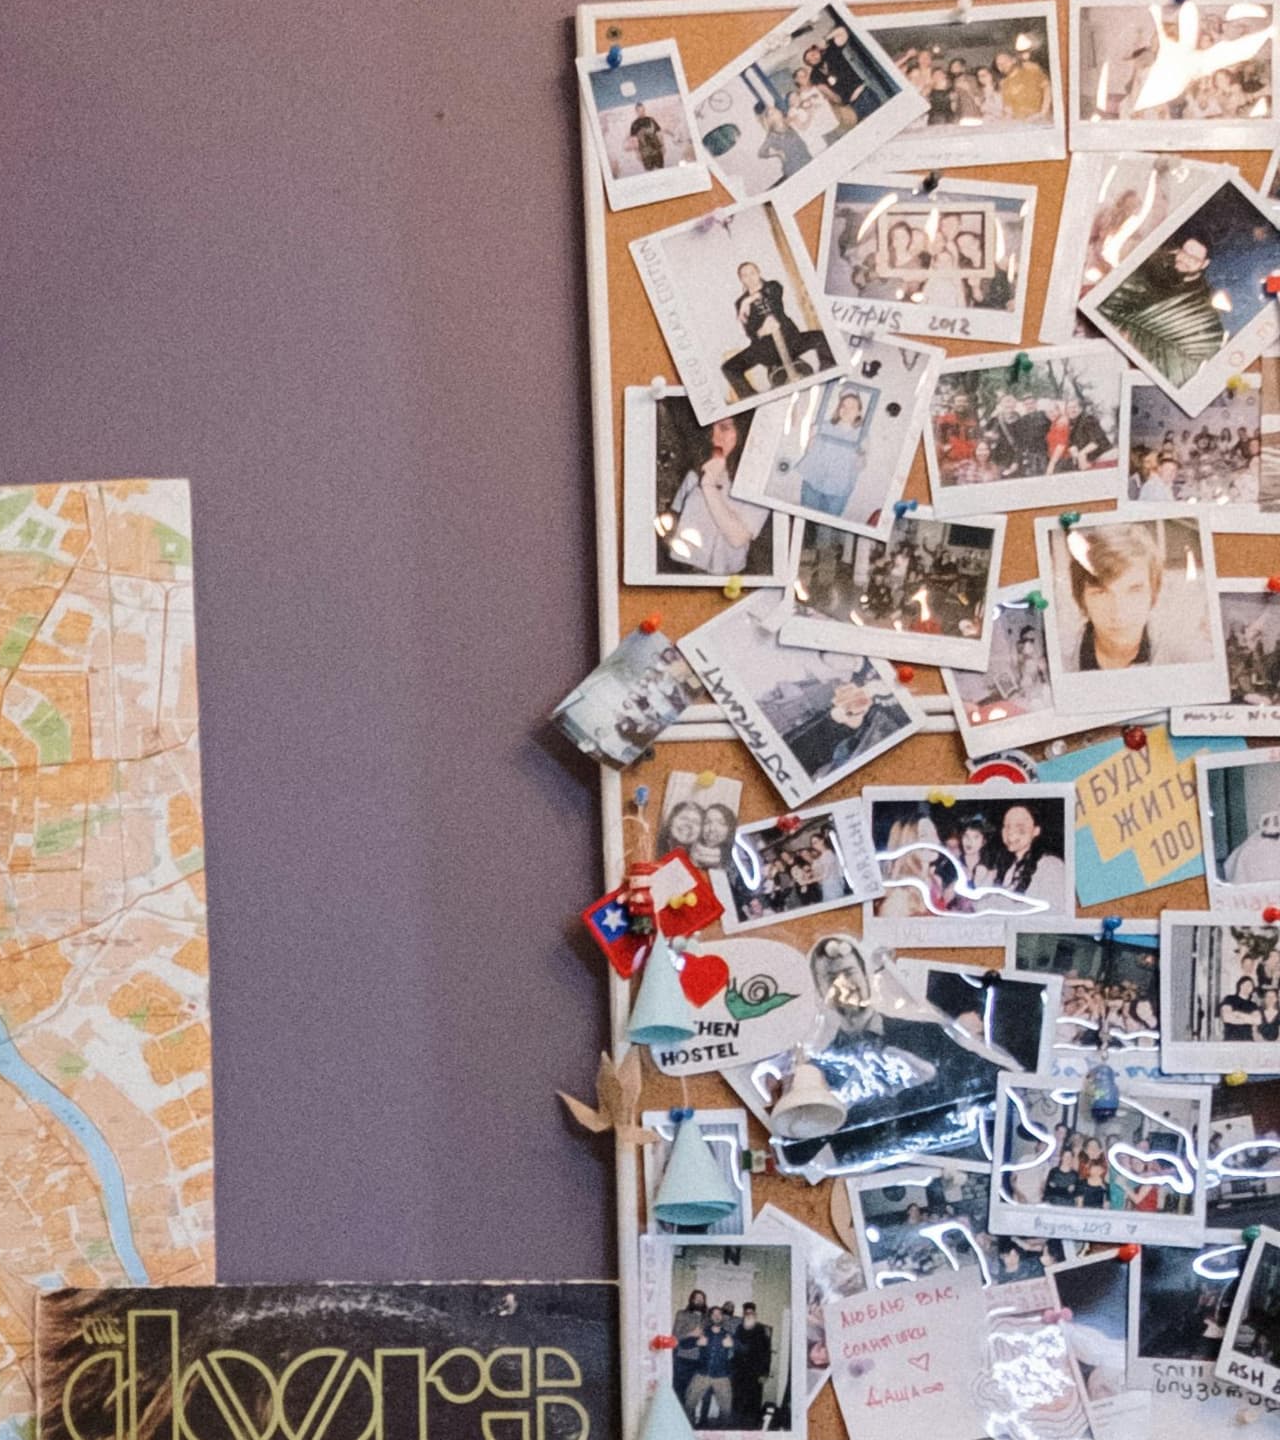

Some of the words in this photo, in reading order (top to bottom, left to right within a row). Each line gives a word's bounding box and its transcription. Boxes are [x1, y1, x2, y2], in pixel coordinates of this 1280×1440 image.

[1089, 746, 1153, 808] БУДУ
[1112, 772, 1197, 843] ЖИТЬ
[1150, 820, 1196, 867] 100
[659, 1042, 740, 1068] HOSTEL
